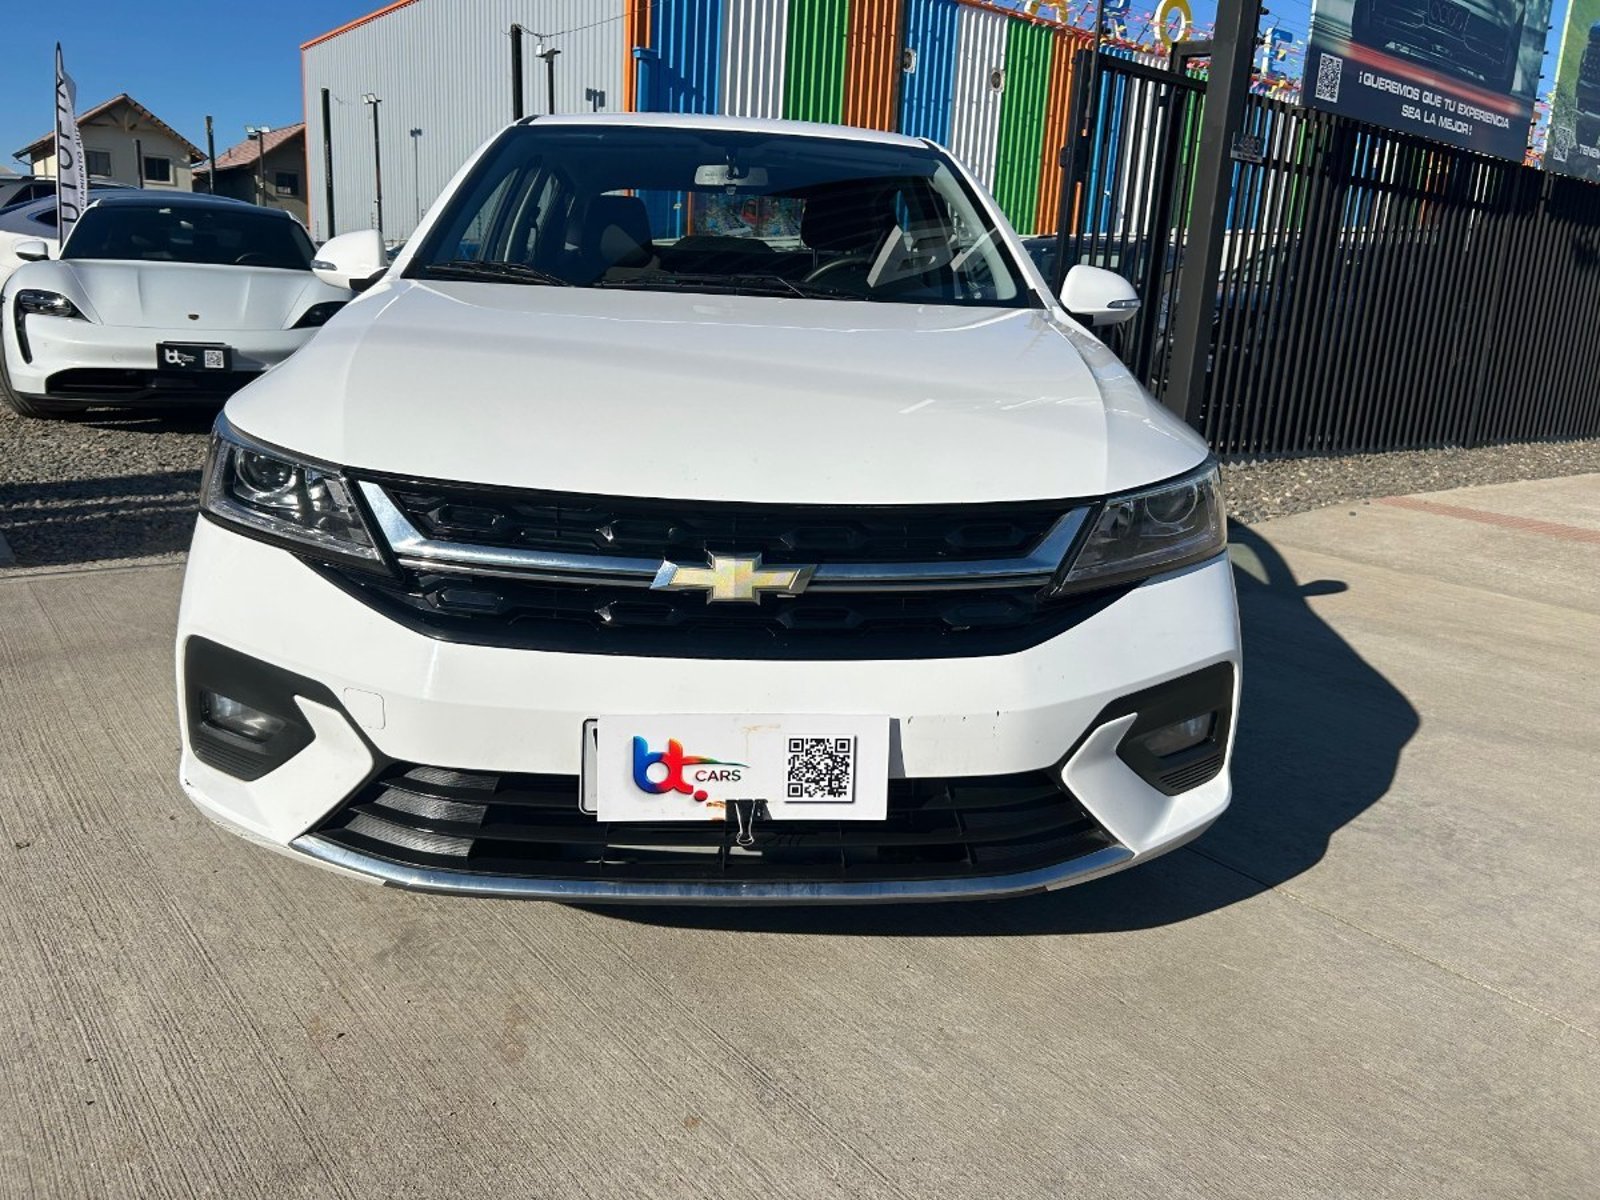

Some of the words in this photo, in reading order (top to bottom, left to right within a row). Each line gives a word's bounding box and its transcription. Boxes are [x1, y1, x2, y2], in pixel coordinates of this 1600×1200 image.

[1401, 104, 1421, 121] SEA
[1424, 111, 1436, 126] LA
[1438, 116, 1473, 136] MEJOR!
[1422, 91, 1442, 108] QUE
[1444, 98, 1456, 112] TU
[1457, 103, 1510, 129] EXPERIENCIA
[695, 769, 742, 782] CARS
